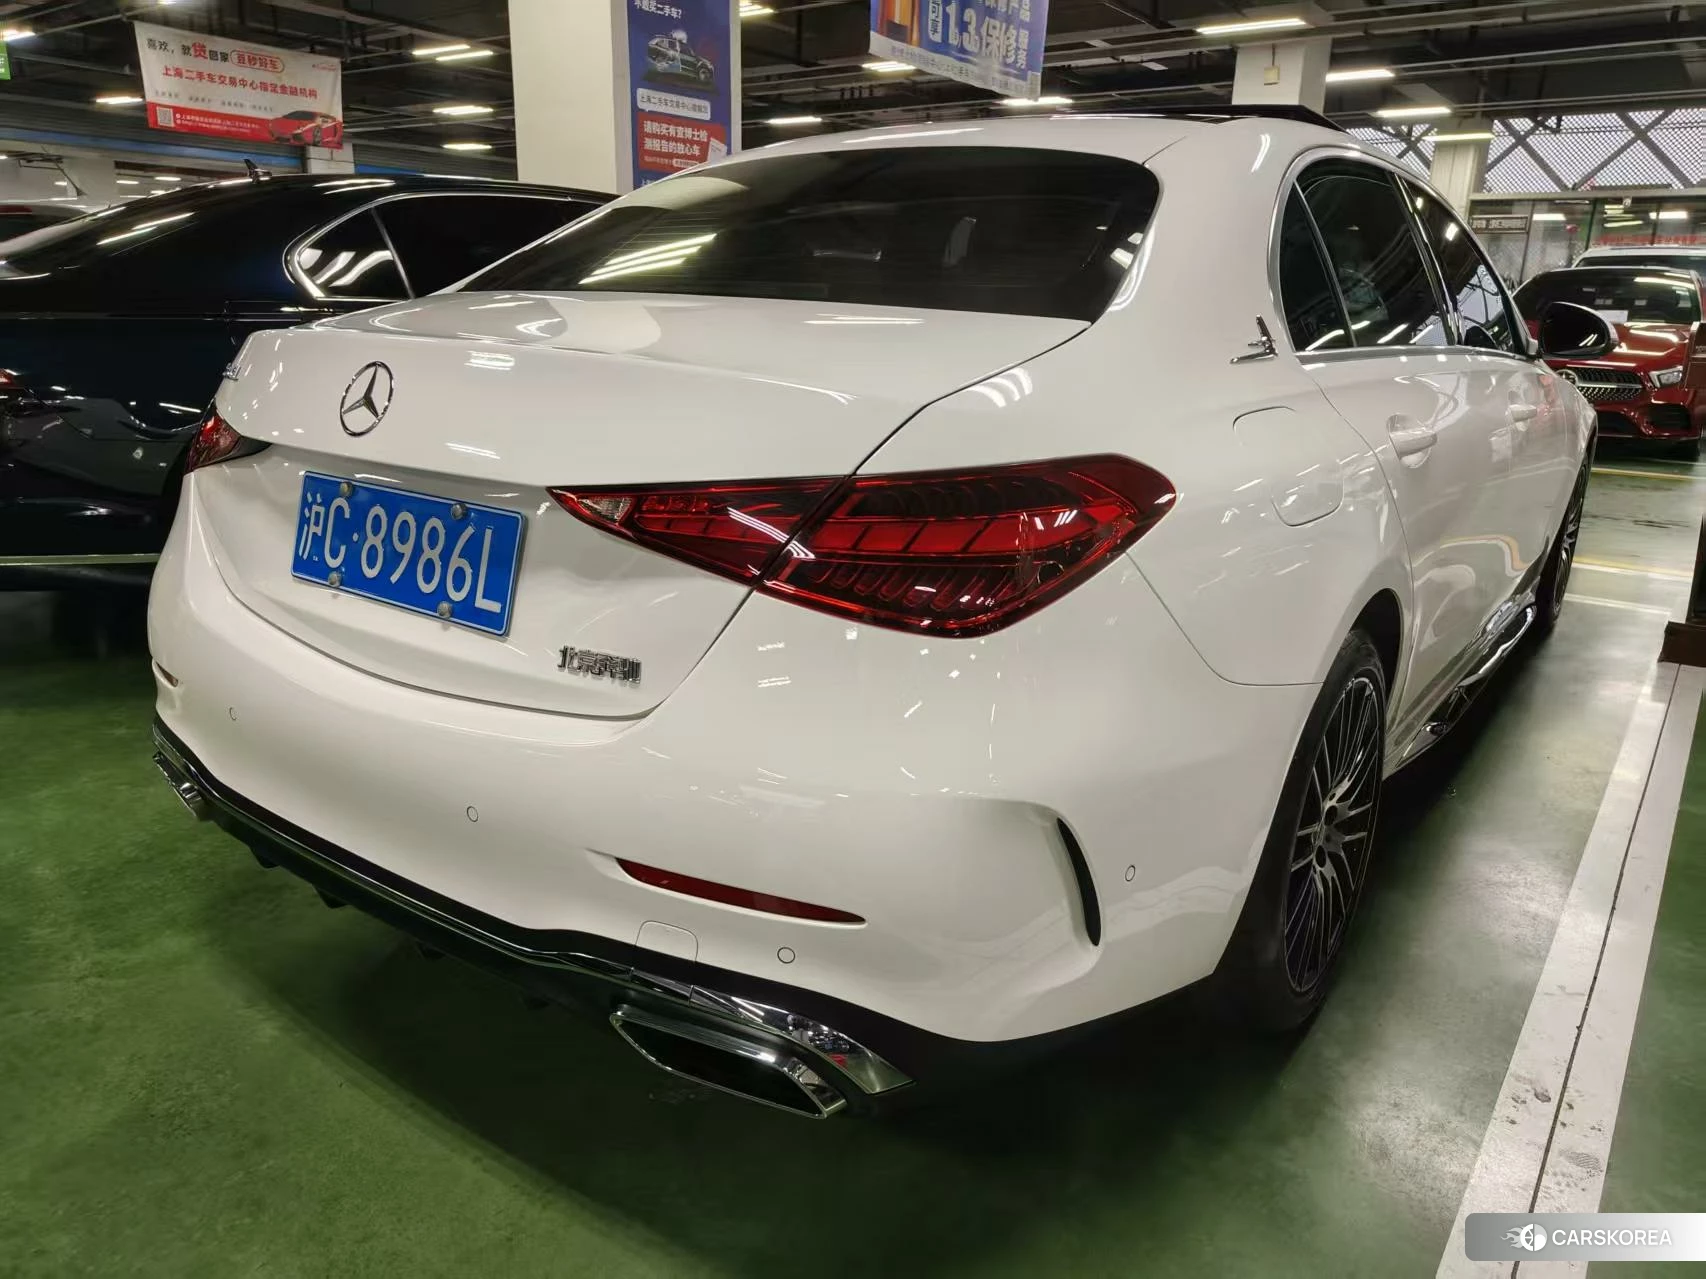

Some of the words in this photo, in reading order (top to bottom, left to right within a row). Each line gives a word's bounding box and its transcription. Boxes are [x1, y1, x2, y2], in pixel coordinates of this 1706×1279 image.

[162, 64, 318, 99] 上海二手车交易中心指定金融机构
[558, 645, 642, 682] 北京奔驰
